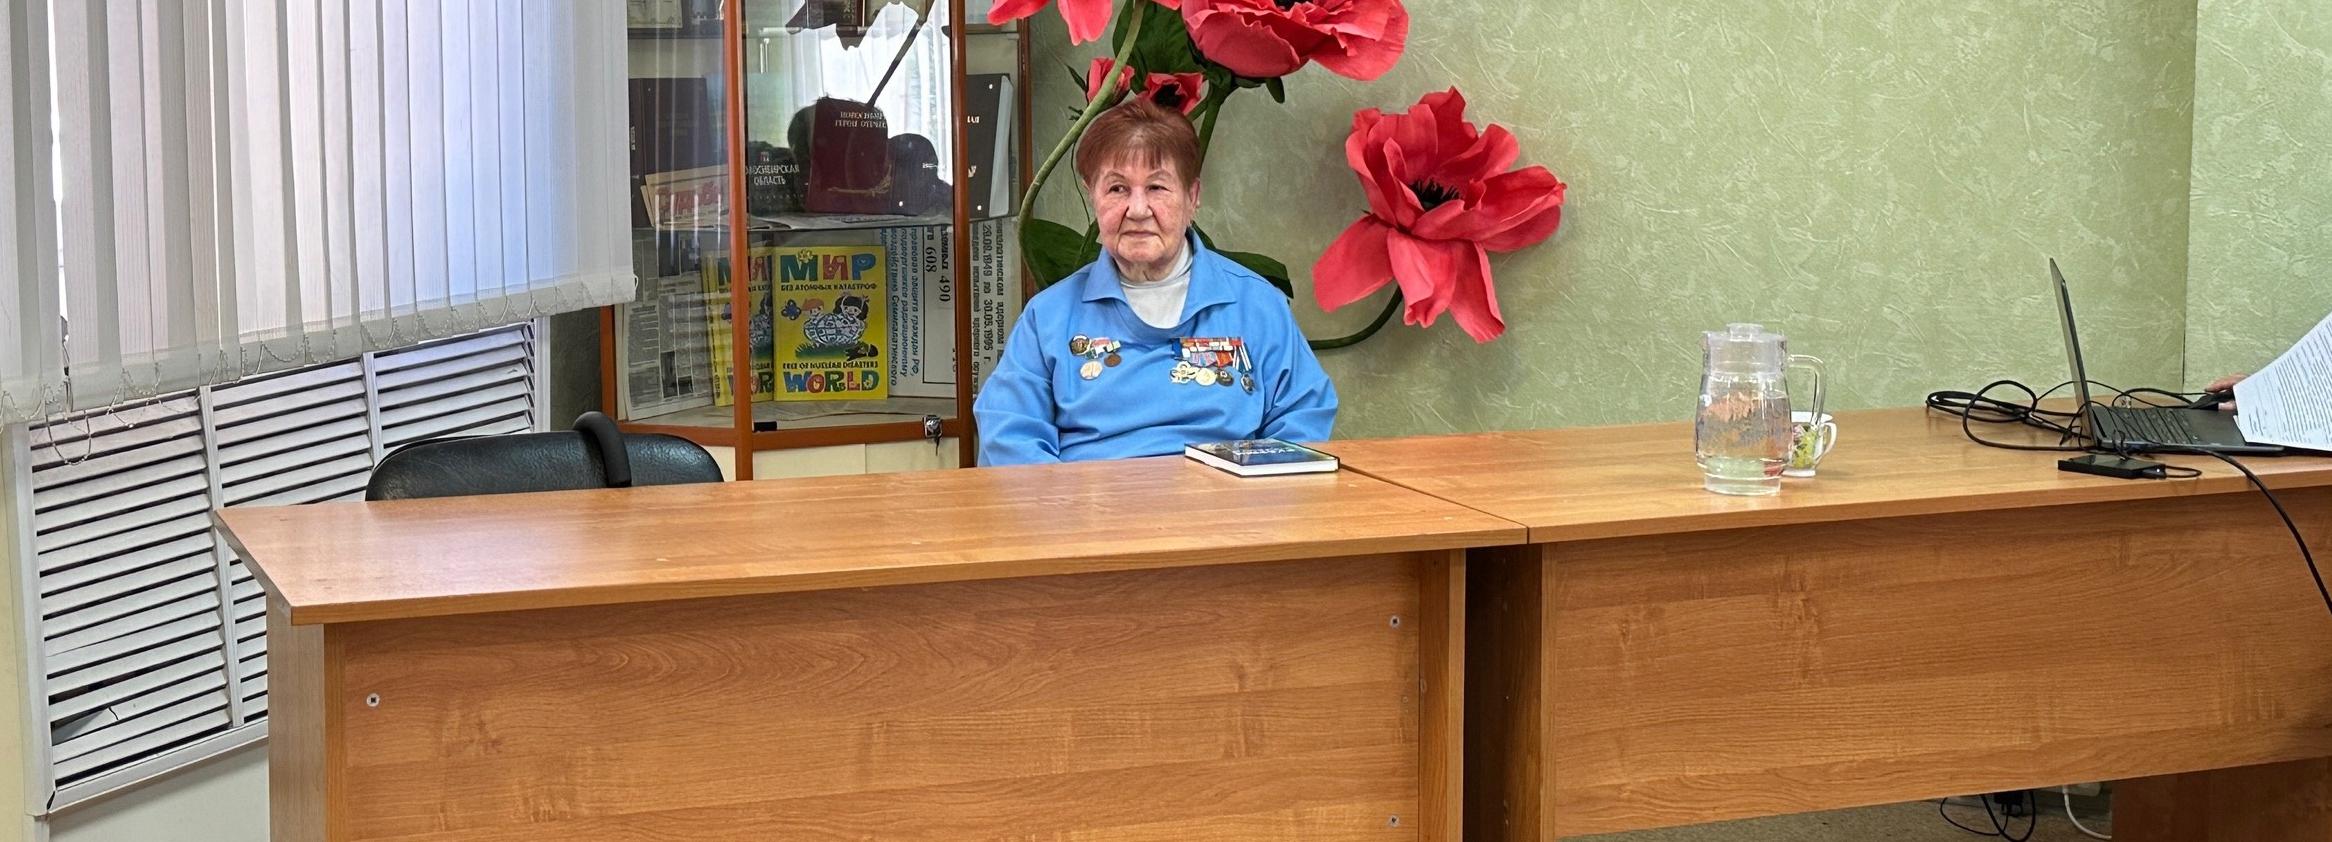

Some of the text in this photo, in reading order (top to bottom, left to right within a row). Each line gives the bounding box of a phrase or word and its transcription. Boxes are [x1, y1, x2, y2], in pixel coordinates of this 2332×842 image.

[753, 175, 786, 186] ОБЛАСТЬ
[780, 253, 876, 282] МИР
[925, 247, 937, 273] 608
[939, 275, 951, 302] 490
[783, 370, 880, 393] WORLD
